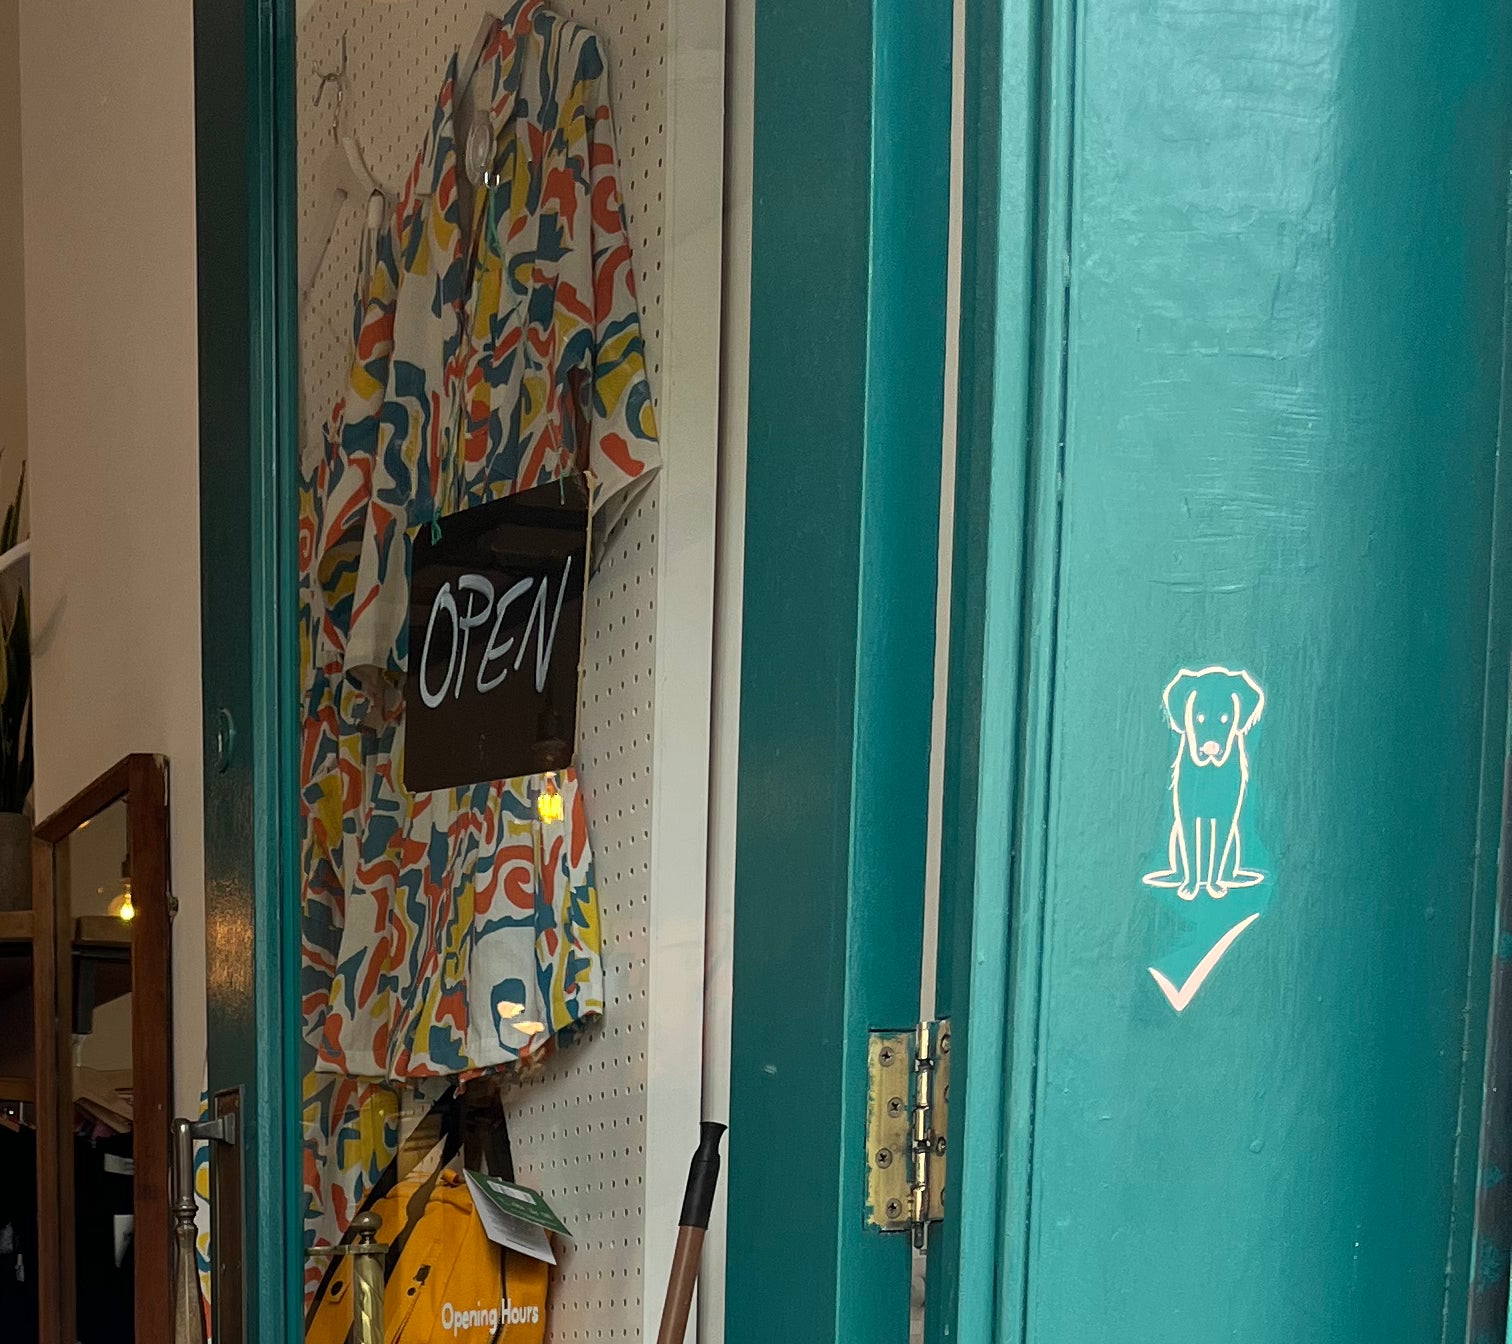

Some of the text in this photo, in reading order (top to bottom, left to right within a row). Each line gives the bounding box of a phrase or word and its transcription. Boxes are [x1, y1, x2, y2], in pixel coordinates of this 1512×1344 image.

[419, 555, 573, 708] OPEN
[441, 1298, 539, 1337] Opening Hours
